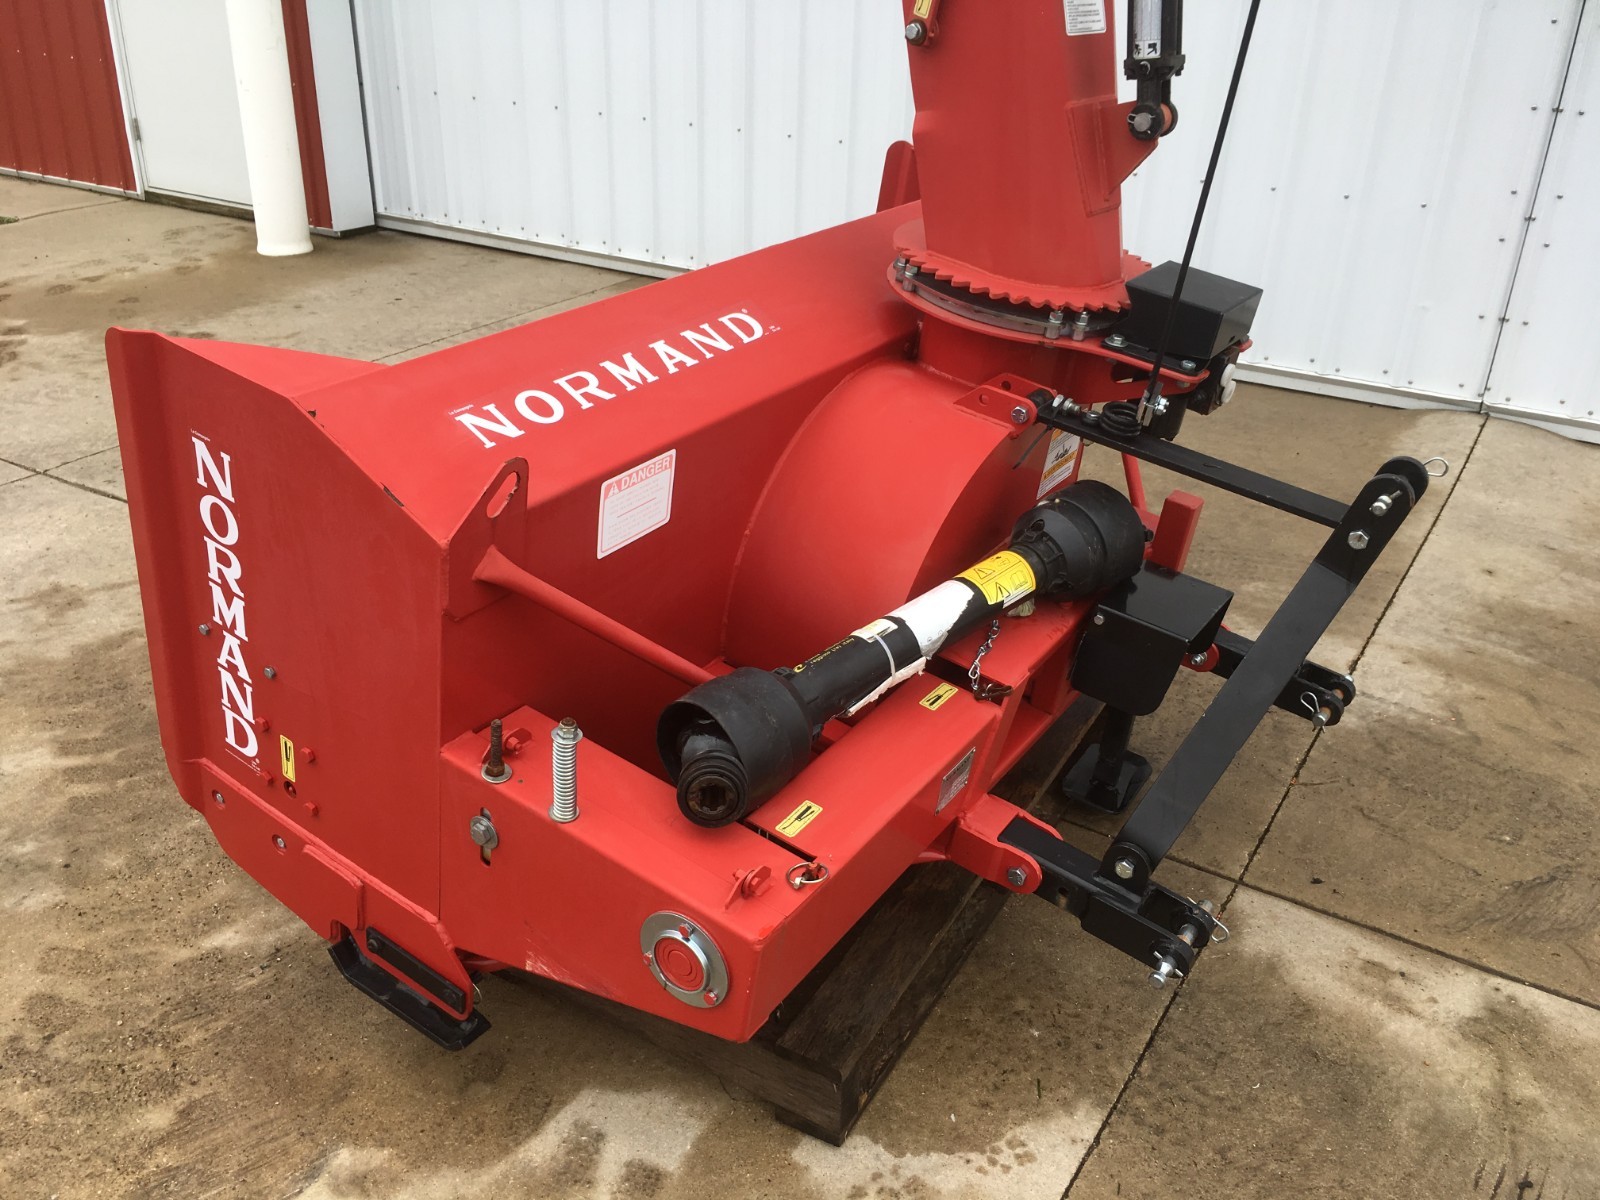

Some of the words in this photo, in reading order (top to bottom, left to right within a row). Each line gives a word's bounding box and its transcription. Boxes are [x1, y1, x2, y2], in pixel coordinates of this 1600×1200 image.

[455, 312, 764, 449] NORMAND
[620, 456, 670, 491] DANGER
[191, 436, 259, 758] NORMAND
